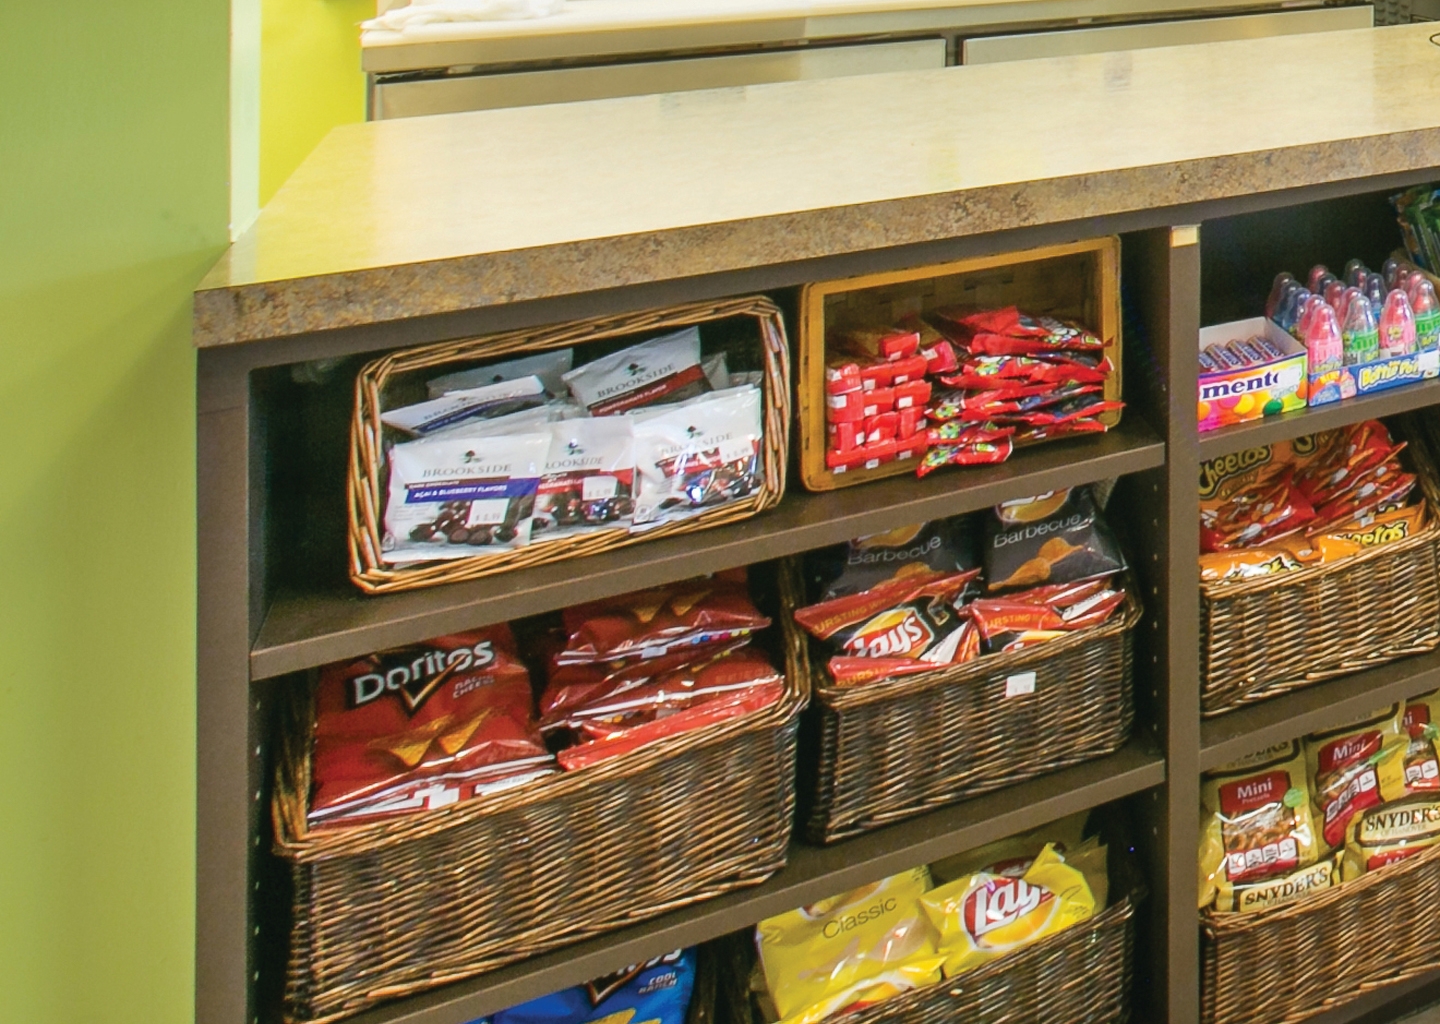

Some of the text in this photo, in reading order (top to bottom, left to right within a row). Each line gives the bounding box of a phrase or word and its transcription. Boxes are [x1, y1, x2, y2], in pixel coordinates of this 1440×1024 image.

[597, 363, 677, 400] BROOKSIDE
[1202, 372, 1279, 400] ment
[422, 463, 512, 478] BROOKSIDE
[993, 513, 1082, 549] Barbecue
[847, 535, 943, 565] Barbecue
[354, 640, 495, 705] Doritos
[1333, 739, 1367, 761] Mini
[1237, 779, 1273, 799] Mini
[1244, 866, 1329, 905] SNYDER'S
[822, 895, 899, 941] Classic
